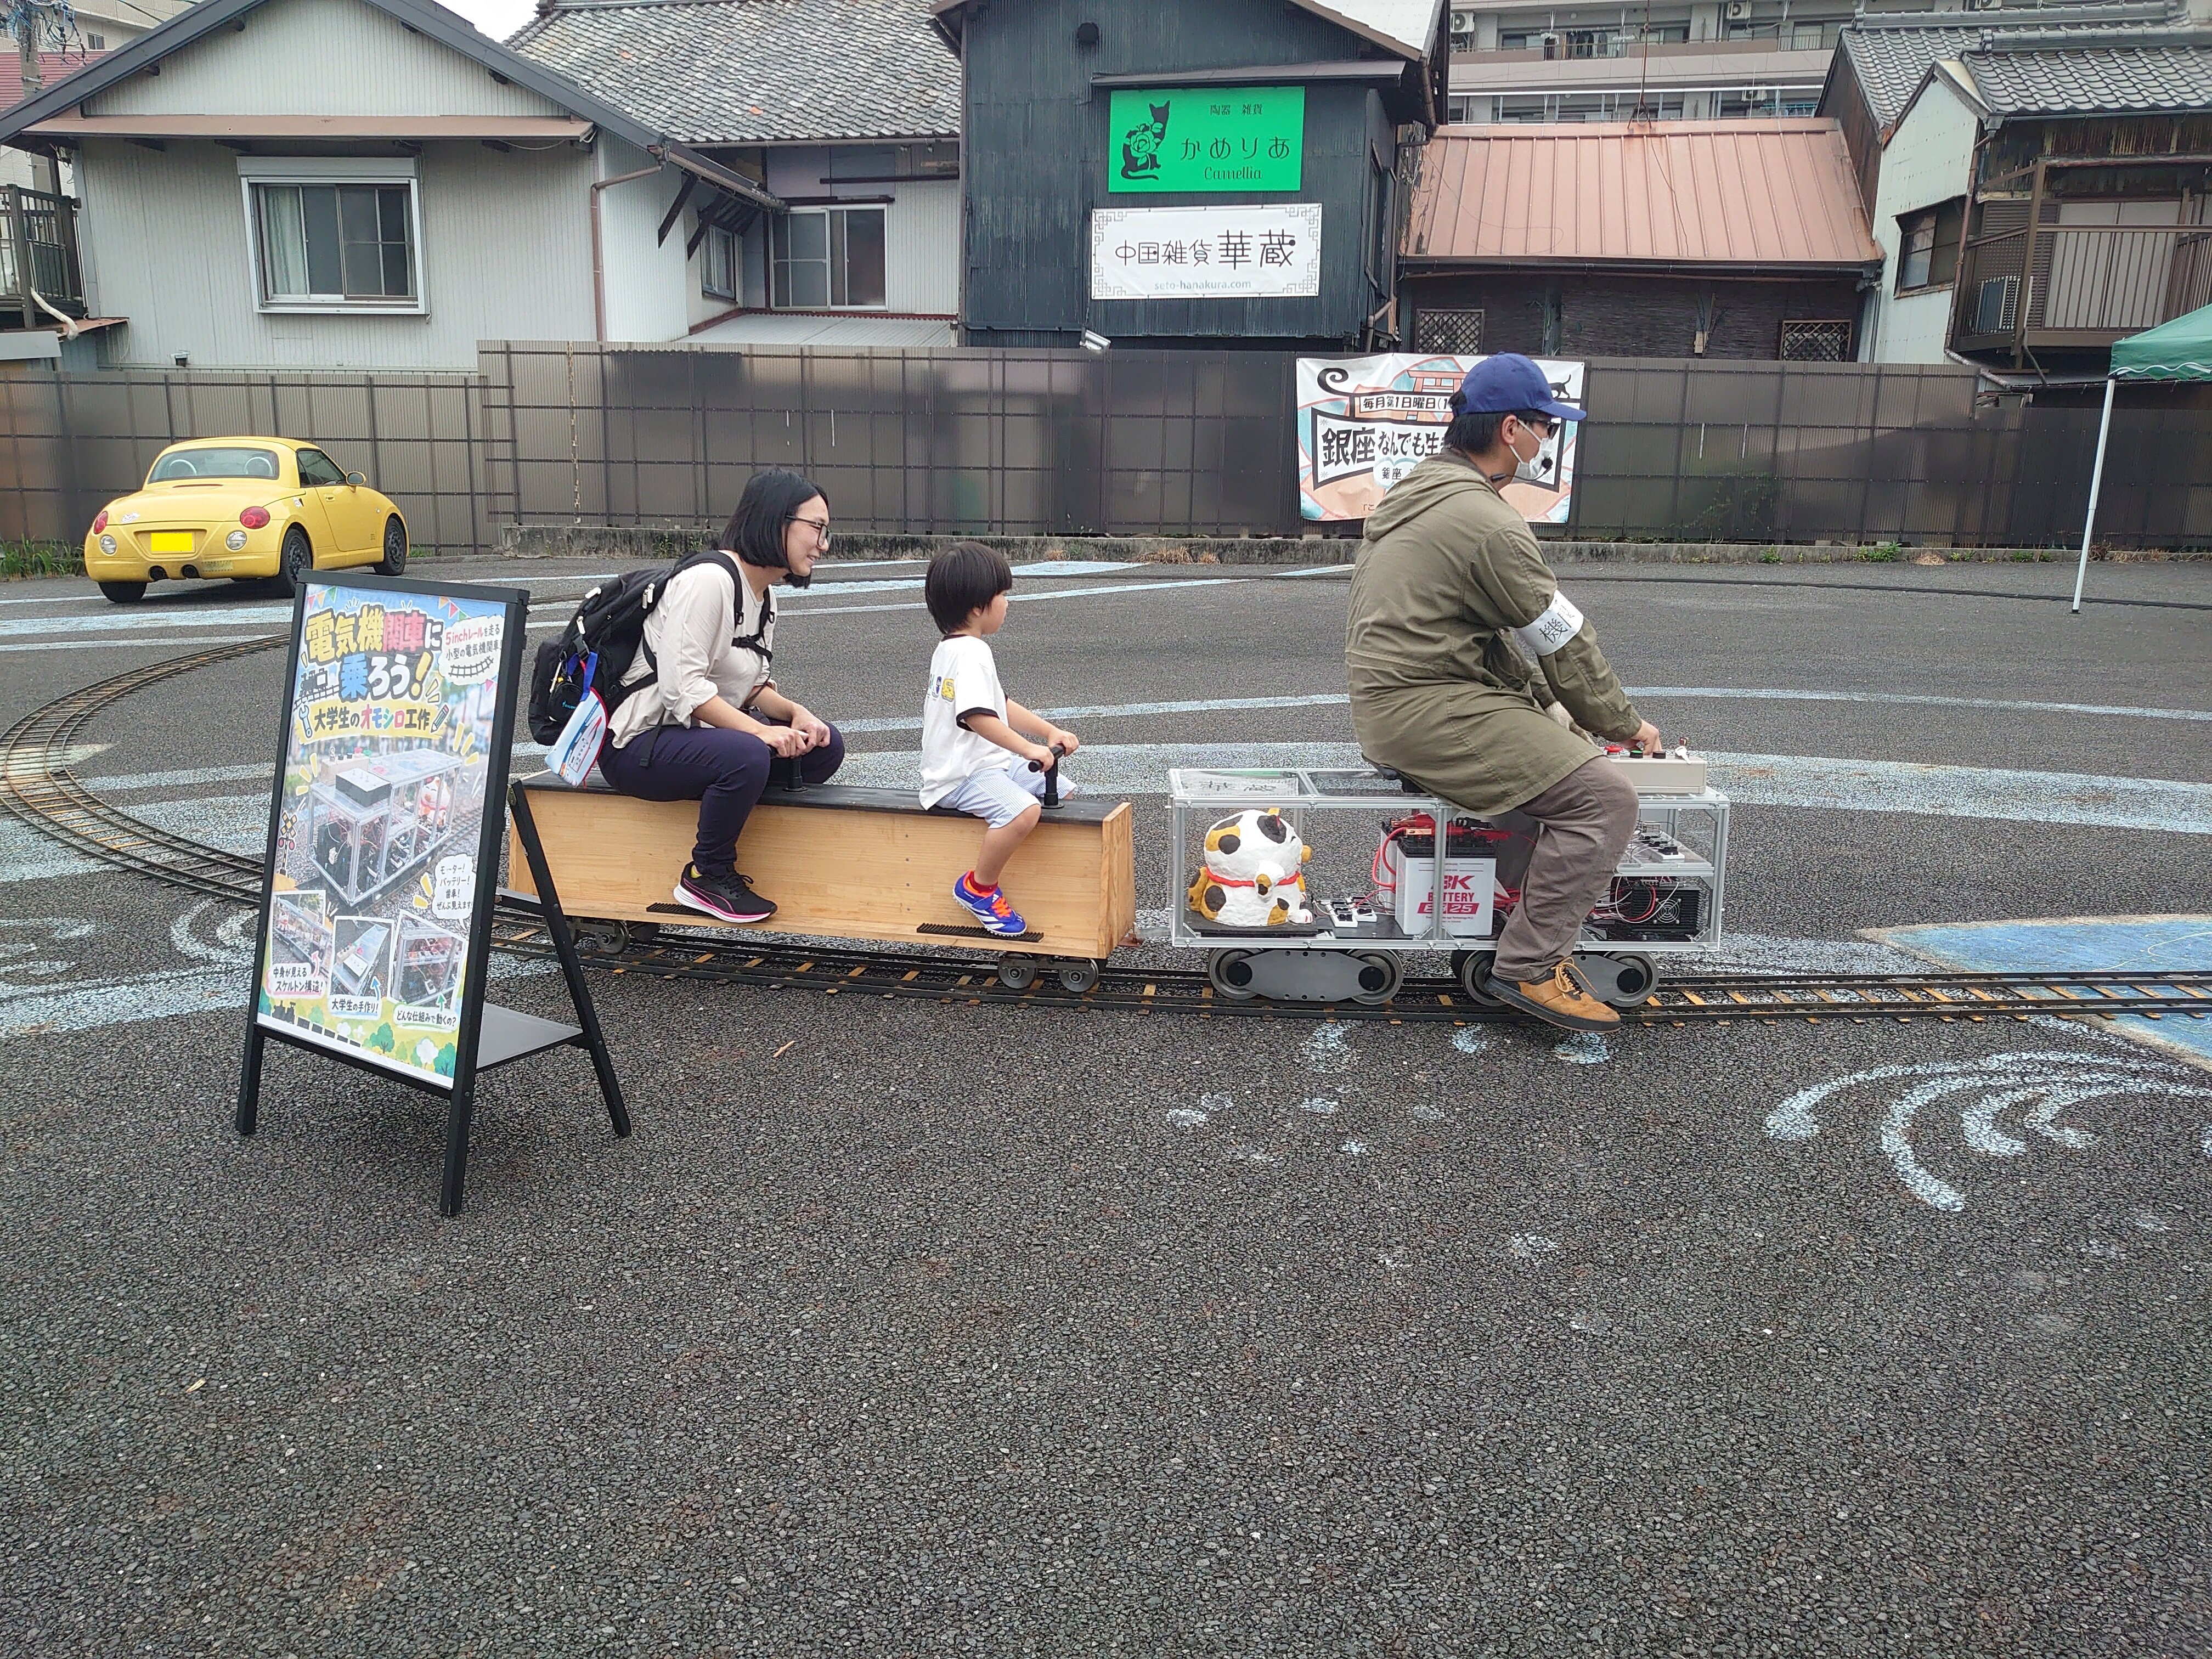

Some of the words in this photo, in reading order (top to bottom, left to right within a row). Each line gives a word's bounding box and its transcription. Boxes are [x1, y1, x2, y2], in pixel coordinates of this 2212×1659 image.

[1210, 104, 1231, 115] 陶器
[1242, 104, 1263, 115] 雑貨
[1180, 136, 1290, 160] かめりあ
[1204, 166, 1263, 180] Camellia
[1115, 239, 1212, 267] 中国雑貨
[1217, 229, 1296, 270] 華蔵
[1154, 280, 1251, 292] seto-hanakura.com
[1322, 427, 1445, 466] 銀座なんでも生
[306, 605, 442, 662] 電気機関車に
[341, 652, 432, 698] 乗ろう!
[314, 704, 431, 732] 大学生のオモシロ工作
[1427, 892, 1475, 902] BTTERY
[273, 967, 307, 978] 中身が見える
[331, 998, 379, 1013] 大学生の手作り!
[397, 1011, 456, 1027] どんな仕組みで動くの?
